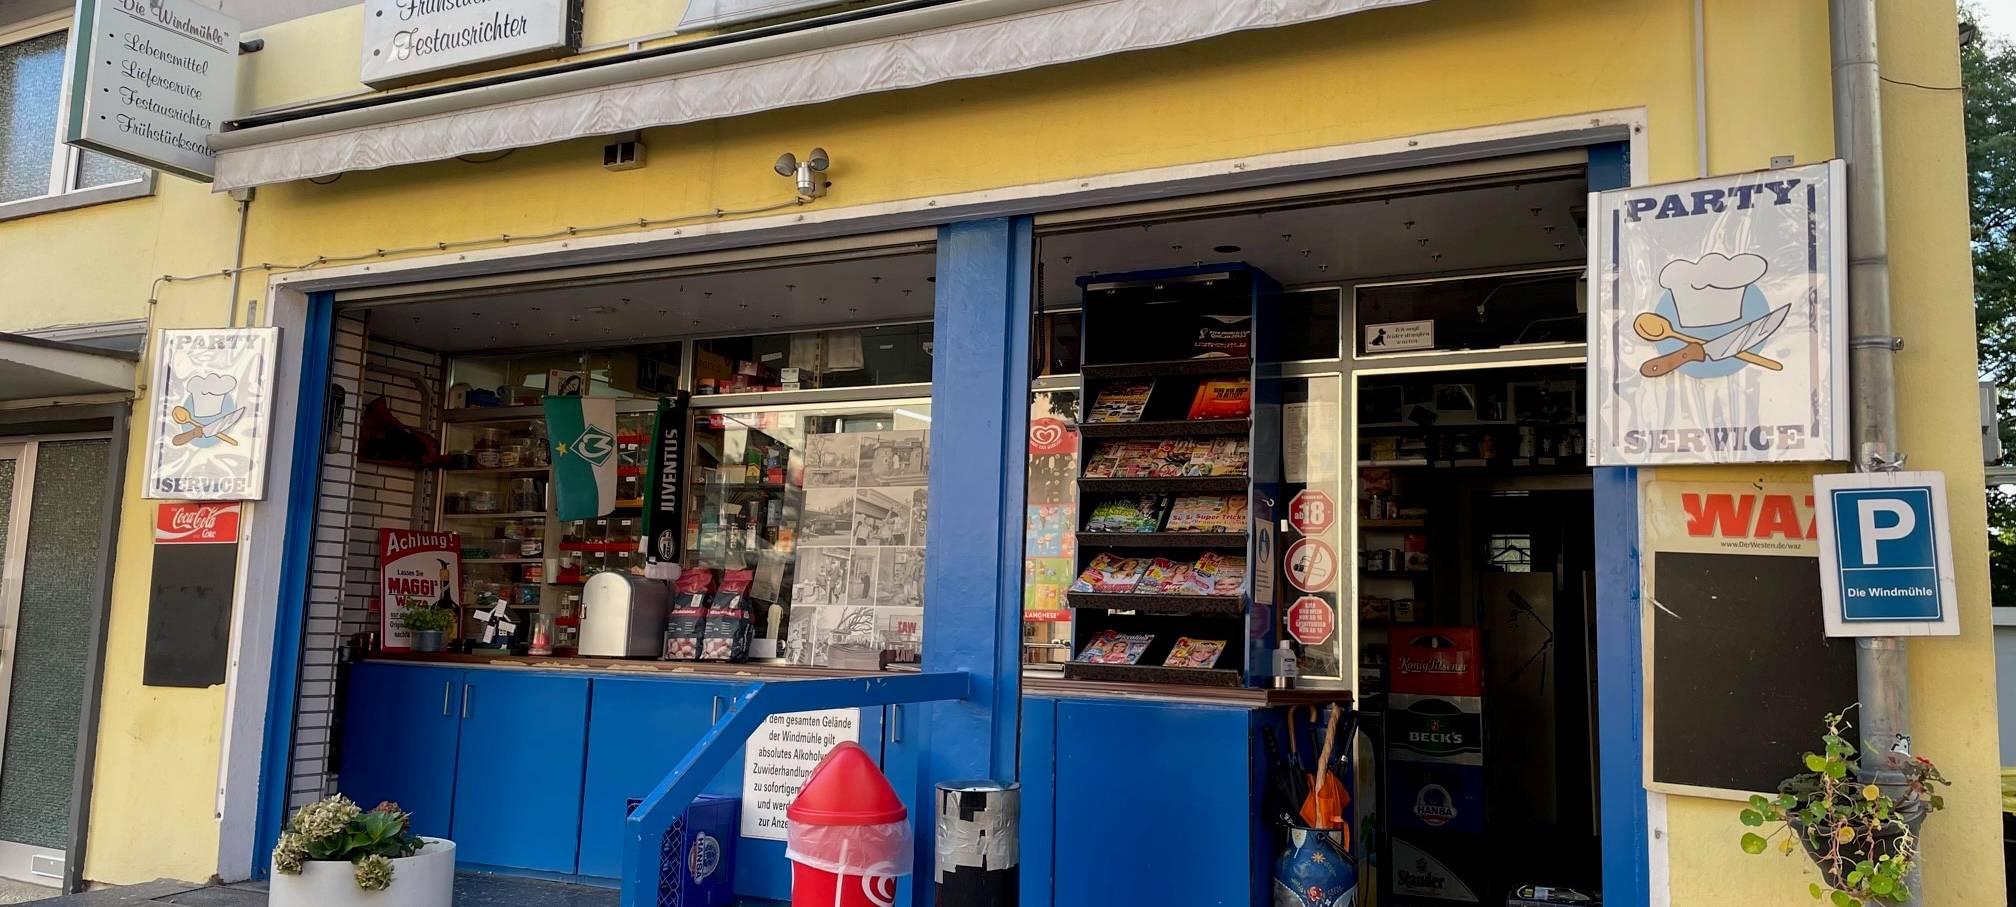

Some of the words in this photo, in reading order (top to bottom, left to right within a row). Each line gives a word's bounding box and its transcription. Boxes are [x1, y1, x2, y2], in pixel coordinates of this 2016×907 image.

[393, 11, 527, 61] Festausrichter
[123, 32, 209, 77] Lebensmittel
[121, 59, 203, 101] Lieferservice
[118, 86, 212, 131] Festausrichter
[1624, 178, 1802, 224] PARTY
[175, 334, 260, 350] PARTY
[1623, 425, 1805, 455] SERVICE
[661, 428, 679, 512] JUVENTUS
[160, 477, 248, 493] SERVICE
[1299, 500, 1325, 525] 18
[1681, 493, 1819, 540] WA
[1857, 498, 1916, 565] P
[386, 531, 454, 557] Achtung!
[1720, 540, 1802, 550] www.DerWesten.de/waz
[1847, 586, 1866, 598] Die
[1868, 585, 1934, 598] Windmühle
[769, 714, 785, 725] dem
[785, 716, 820, 727] gesamten
[822, 716, 852, 729] Gelände
[768, 730, 781, 741] der
[782, 730, 822, 744] Windmühle
[823, 734, 836, 747] gilt
[1409, 732, 1464, 744] BECK'S
[758, 748, 792, 759] absolutes
[793, 749, 827, 761] Alkoholv
[753, 782, 762, 792] zu
[757, 799, 771, 810] und
[1416, 805, 1454, 818] HANSA
[758, 818, 770, 827] zur
[771, 817, 788, 829] Anze
[695, 837, 705, 879] HANSA
